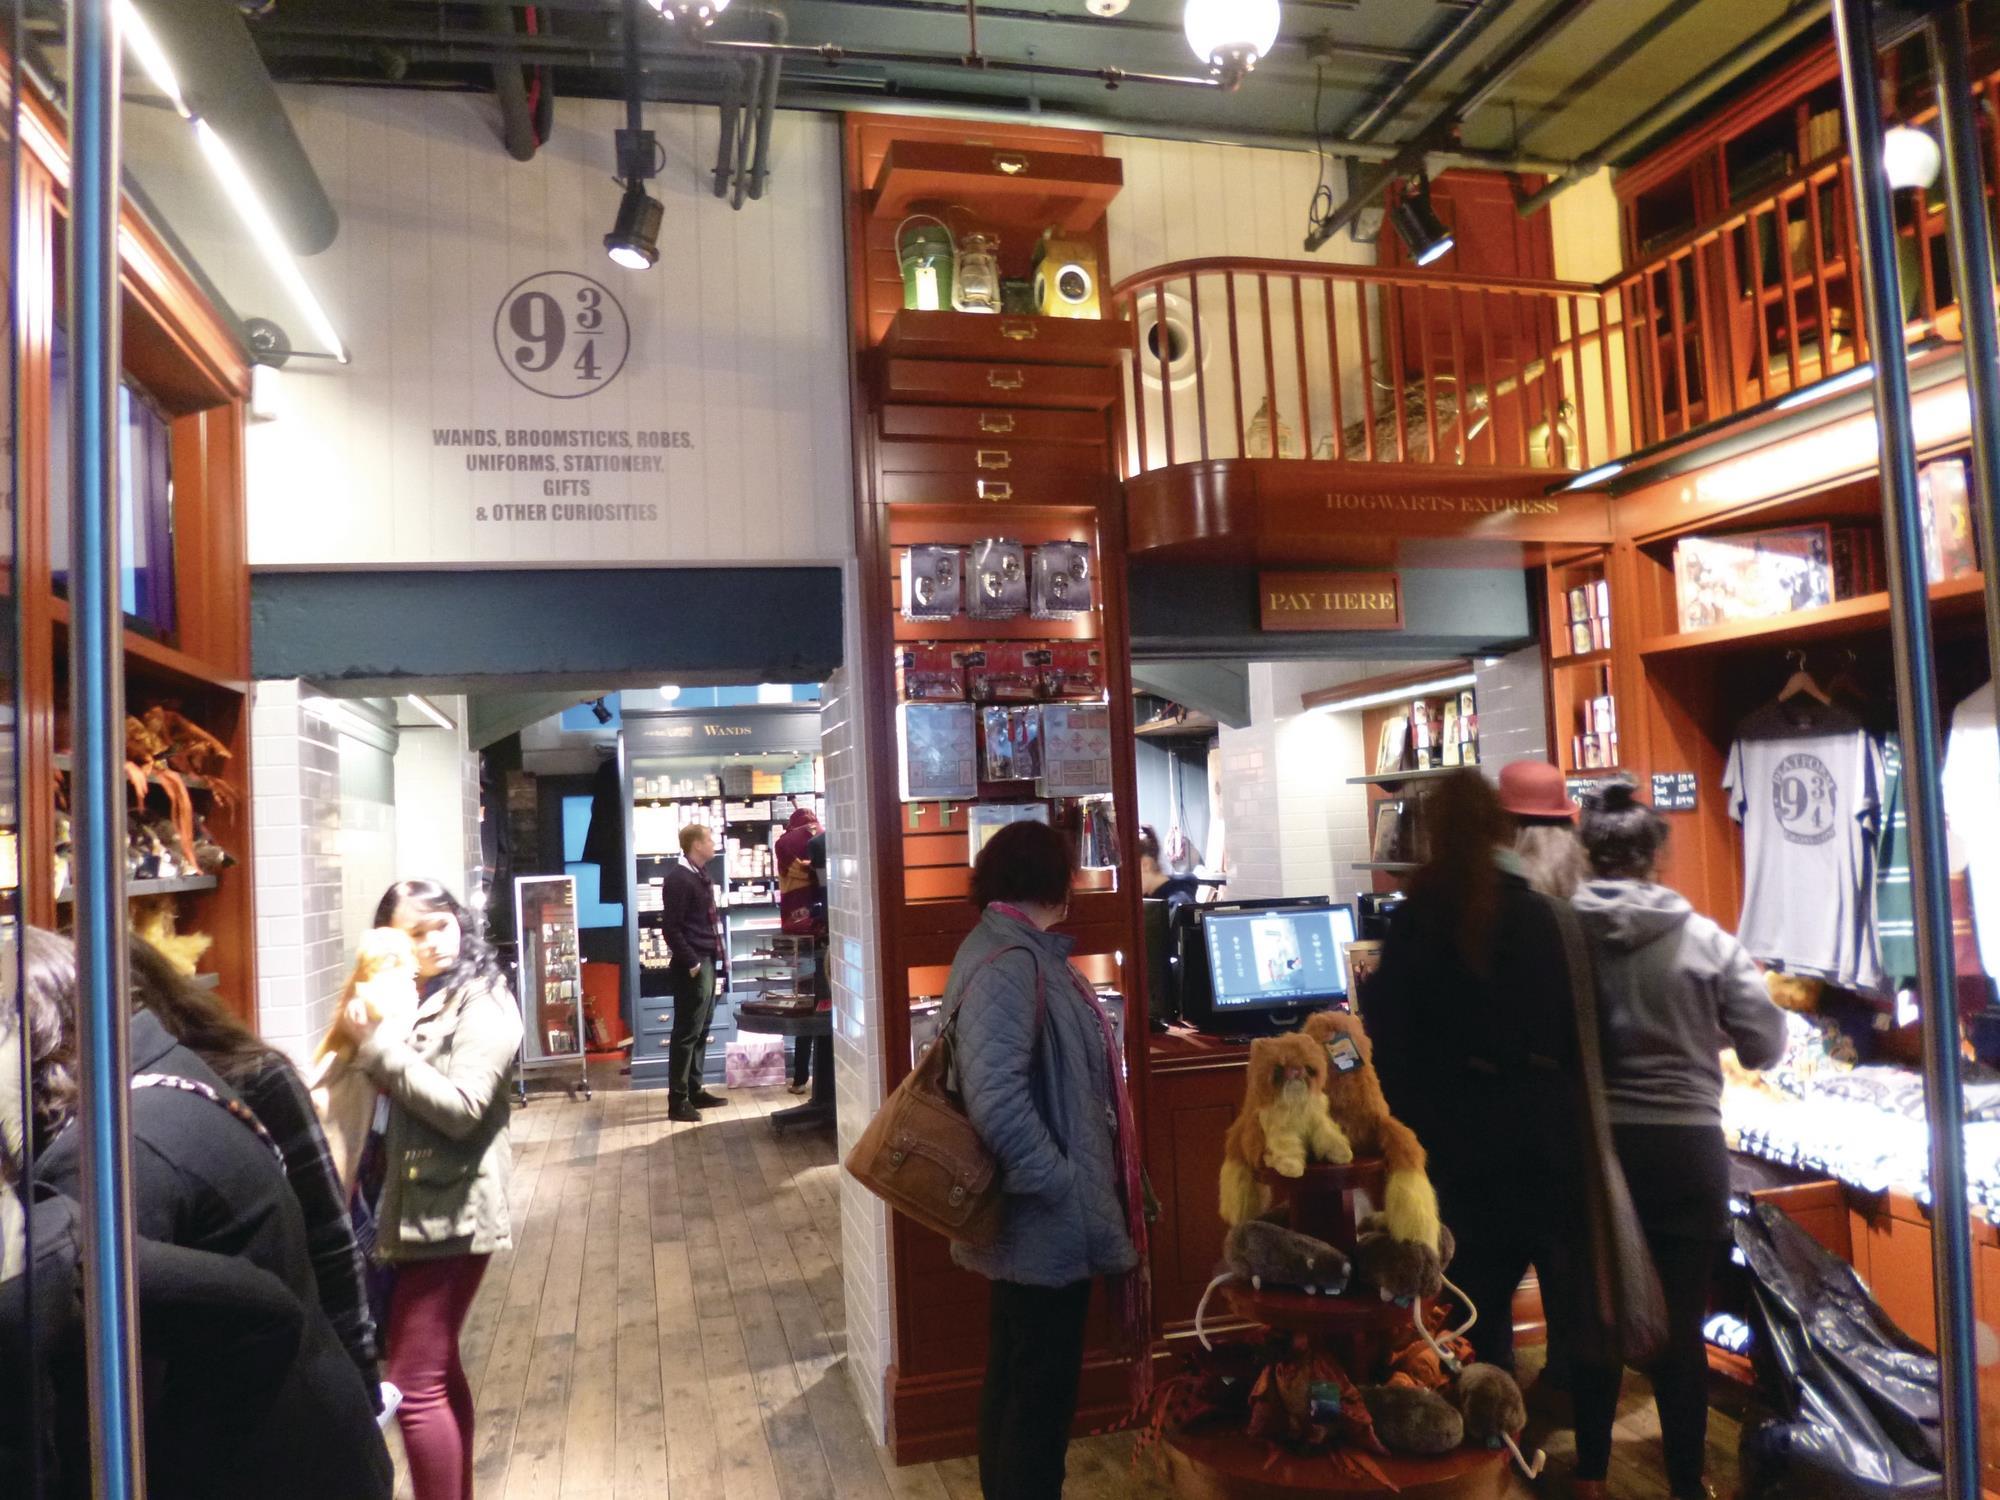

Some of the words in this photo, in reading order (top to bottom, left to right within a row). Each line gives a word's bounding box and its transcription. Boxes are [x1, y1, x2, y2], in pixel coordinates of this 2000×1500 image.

[432, 429, 501, 447] WANDS,
[505, 429, 633, 449] BROOMSTICKS,
[637, 431, 695, 450] ROBES,
[466, 454, 559, 472] UNIFORMS,
[543, 479, 590, 496] GIFTS
[476, 506, 488, 521] &
[492, 504, 547, 521] OTHER
[551, 503, 657, 521] CURIOSITIES
[1327, 493, 1455, 511] HOGWARTS
[1461, 498, 1559, 514] EXPRESS
[1270, 593, 1316, 610] PAY
[1323, 593, 1394, 610] HERE
